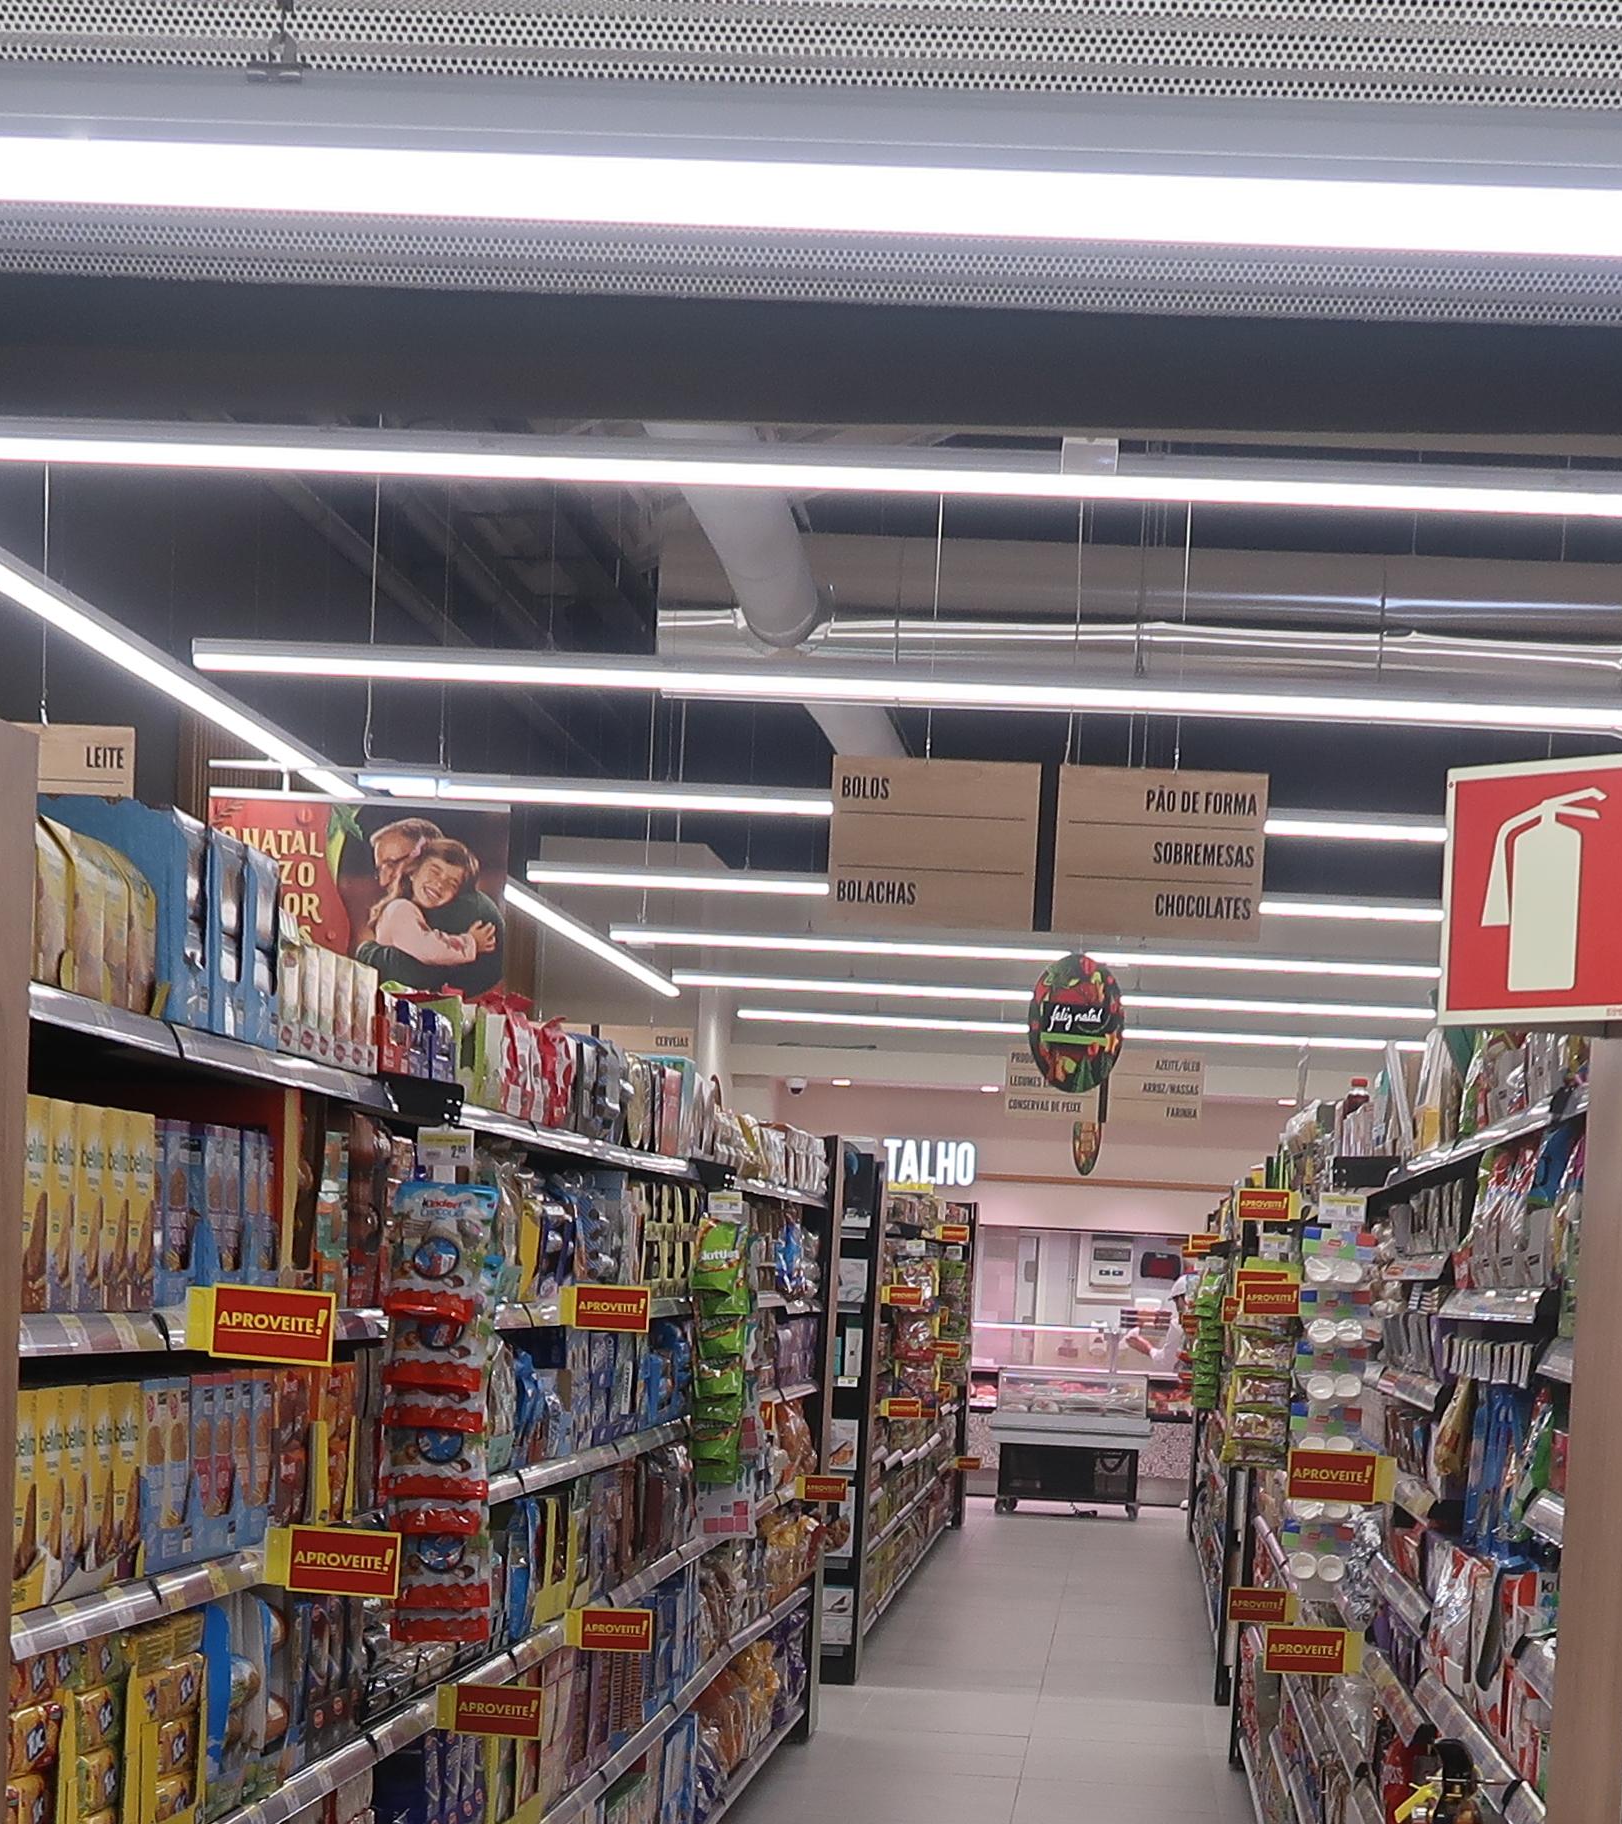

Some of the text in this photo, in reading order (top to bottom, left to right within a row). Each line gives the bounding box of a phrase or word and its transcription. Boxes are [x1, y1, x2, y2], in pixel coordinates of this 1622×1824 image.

[85, 746, 124, 769] LEITE
[841, 776, 890, 800] BOLOS
[1145, 788, 1257, 816] PÃO DE FORMA
[1153, 842, 1255, 868] SOBREMESAS
[836, 882, 917, 905] BOLACHAS
[1155, 894, 1252, 920] CHOCOLATES
[1048, 1005, 1102, 1031] feliz natal
[1011, 1052, 1035, 1063] PRODU
[1010, 1076, 1041, 1087] LEGUMES
[1008, 1100, 1081, 1113] CONSERVAS DE PEIXE
[1165, 1107, 1197, 1118] FARINHA
[883, 1138, 976, 1186] TALHO
[1239, 1193, 1290, 1211] APROVEITE!
[578, 1296, 647, 1316] APROVEITE!
[1244, 1287, 1299, 1305] APROVEITE!
[217, 1309, 328, 1336] APROVEITE!
[1292, 1464, 1374, 1484] APROVEITE!
[293, 1548, 394, 1571] APROVEITE!
[1230, 1598, 1285, 1613] APROVEITE!
[582, 1619, 648, 1637] APROVEITE!
[1268, 1639, 1344, 1660] APROVEITE!
[457, 1697, 539, 1721] APROVEITE!
